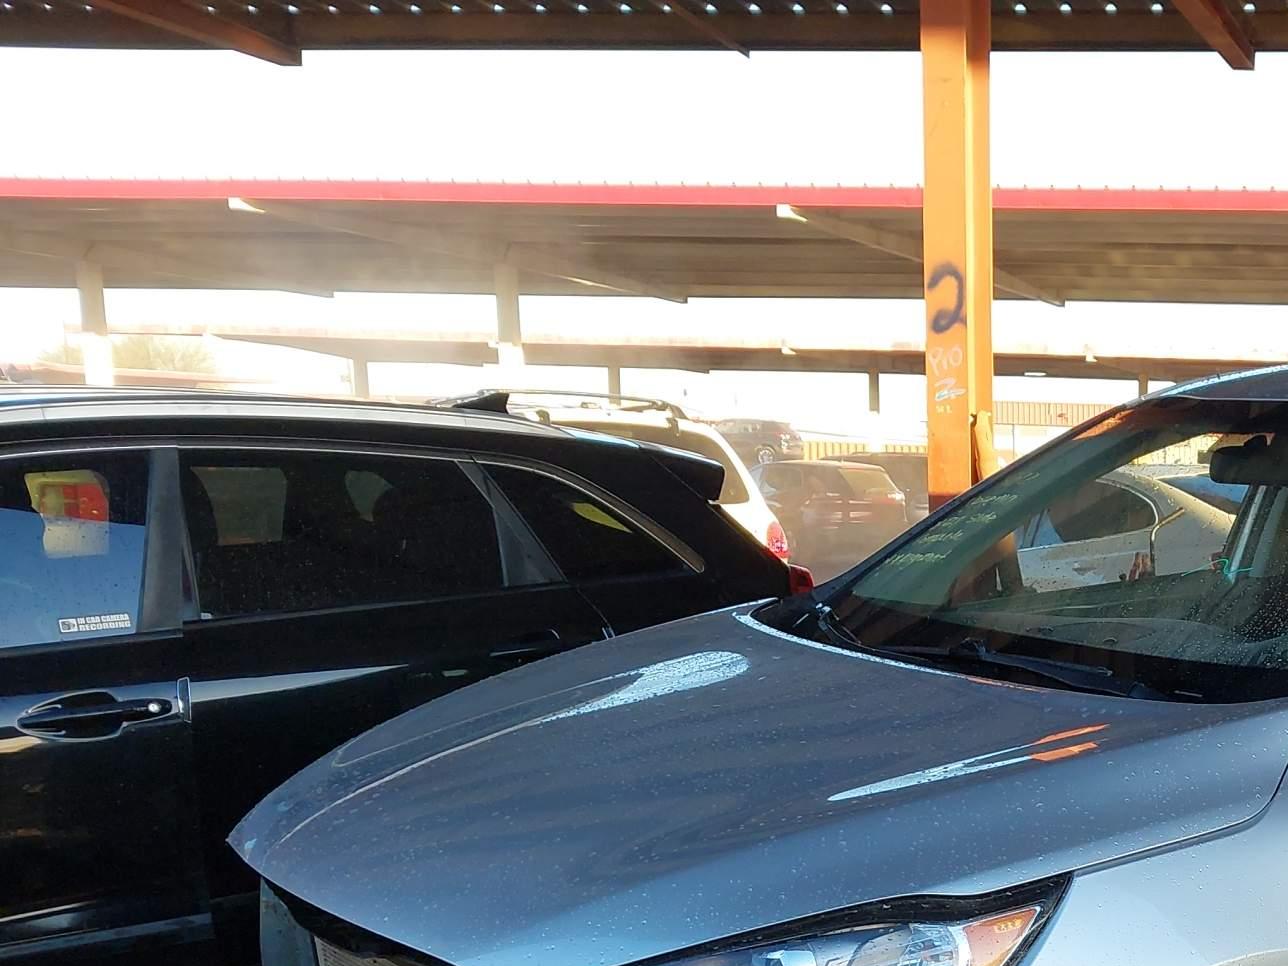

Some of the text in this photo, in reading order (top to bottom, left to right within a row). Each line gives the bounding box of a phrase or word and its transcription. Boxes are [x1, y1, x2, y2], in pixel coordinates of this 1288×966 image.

[927, 261, 967, 334] 2
[100, 613, 129, 622] CAMERA
[79, 621, 131, 631] RECORDING
